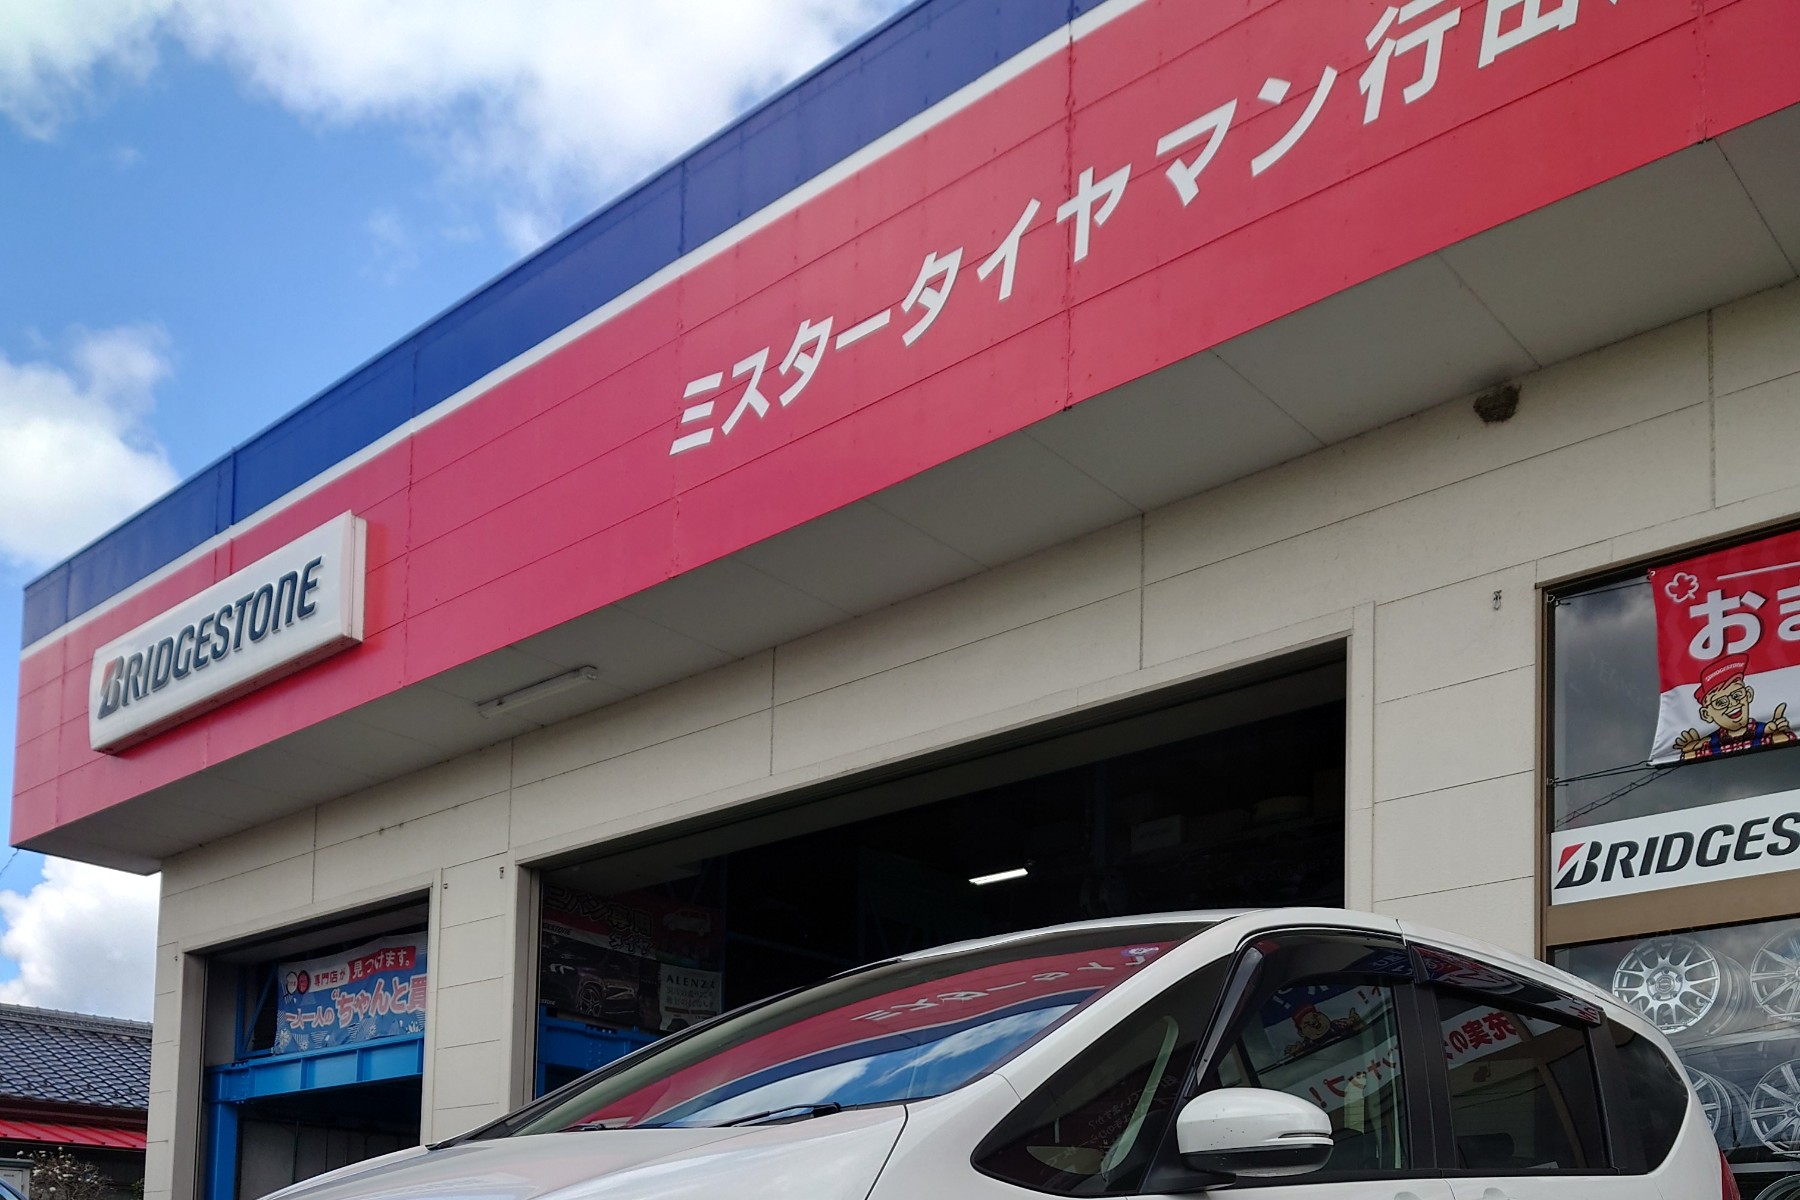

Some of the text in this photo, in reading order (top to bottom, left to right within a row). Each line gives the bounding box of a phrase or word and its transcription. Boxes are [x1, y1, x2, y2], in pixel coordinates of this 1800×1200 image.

[669, 0, 1620, 456] ミスタータイヤマン行田
[97, 555, 325, 720] BRIDGESTONE
[1554, 812, 1800, 890] BRIDGES
[353, 950, 411, 979] 見つけます。
